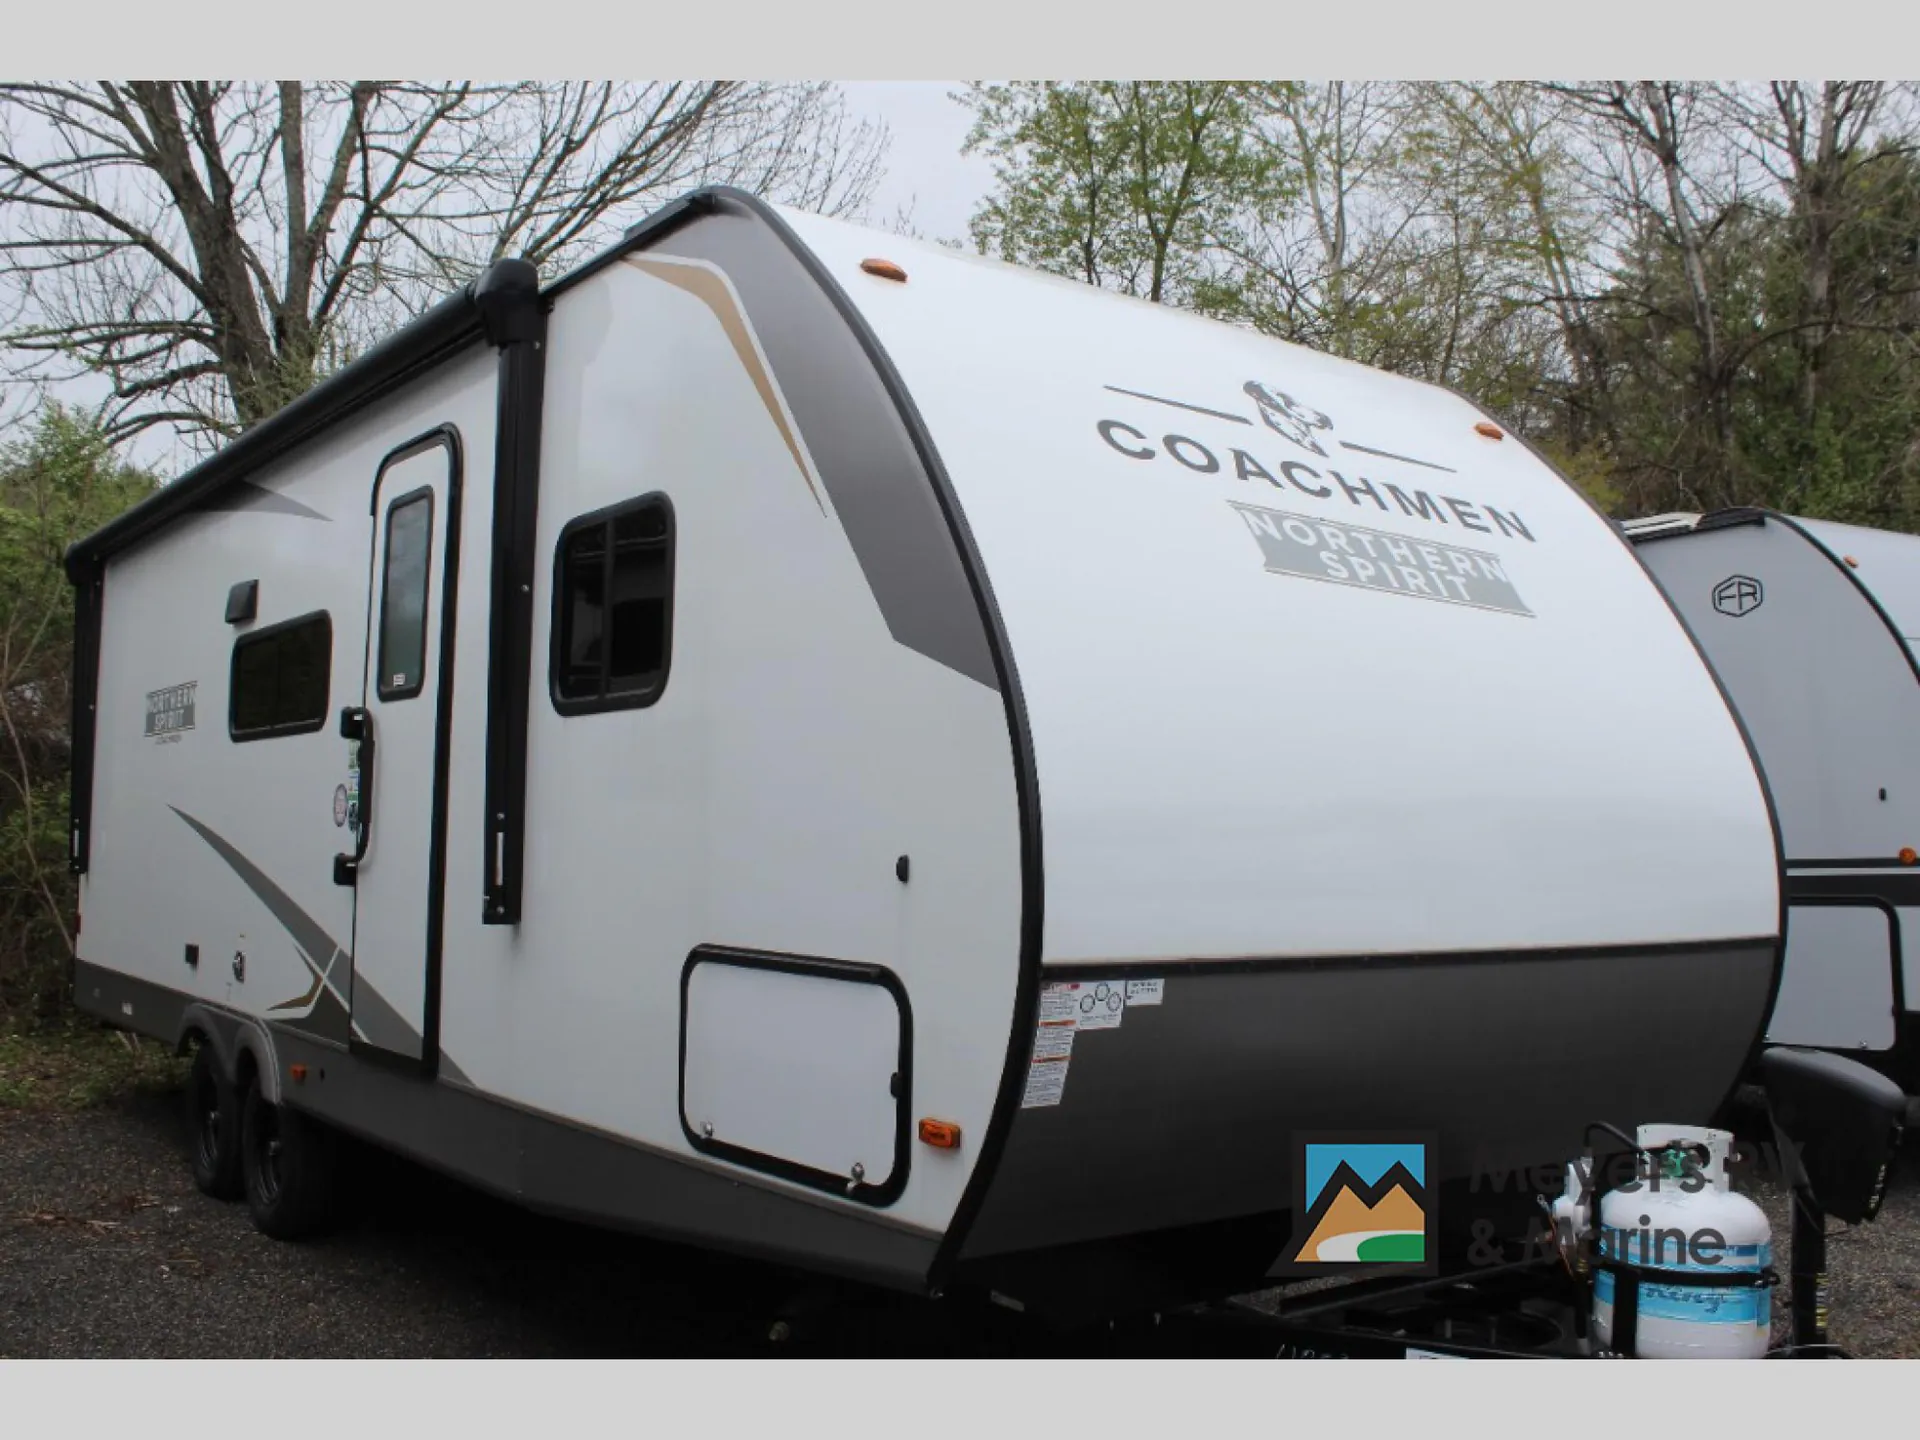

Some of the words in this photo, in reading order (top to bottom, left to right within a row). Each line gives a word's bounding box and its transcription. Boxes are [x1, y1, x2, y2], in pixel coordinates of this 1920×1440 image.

[1096, 419, 1536, 542] COACHMEN
[1241, 506, 1508, 582] NORTHERN
[1320, 551, 1470, 600] SPIRIT
